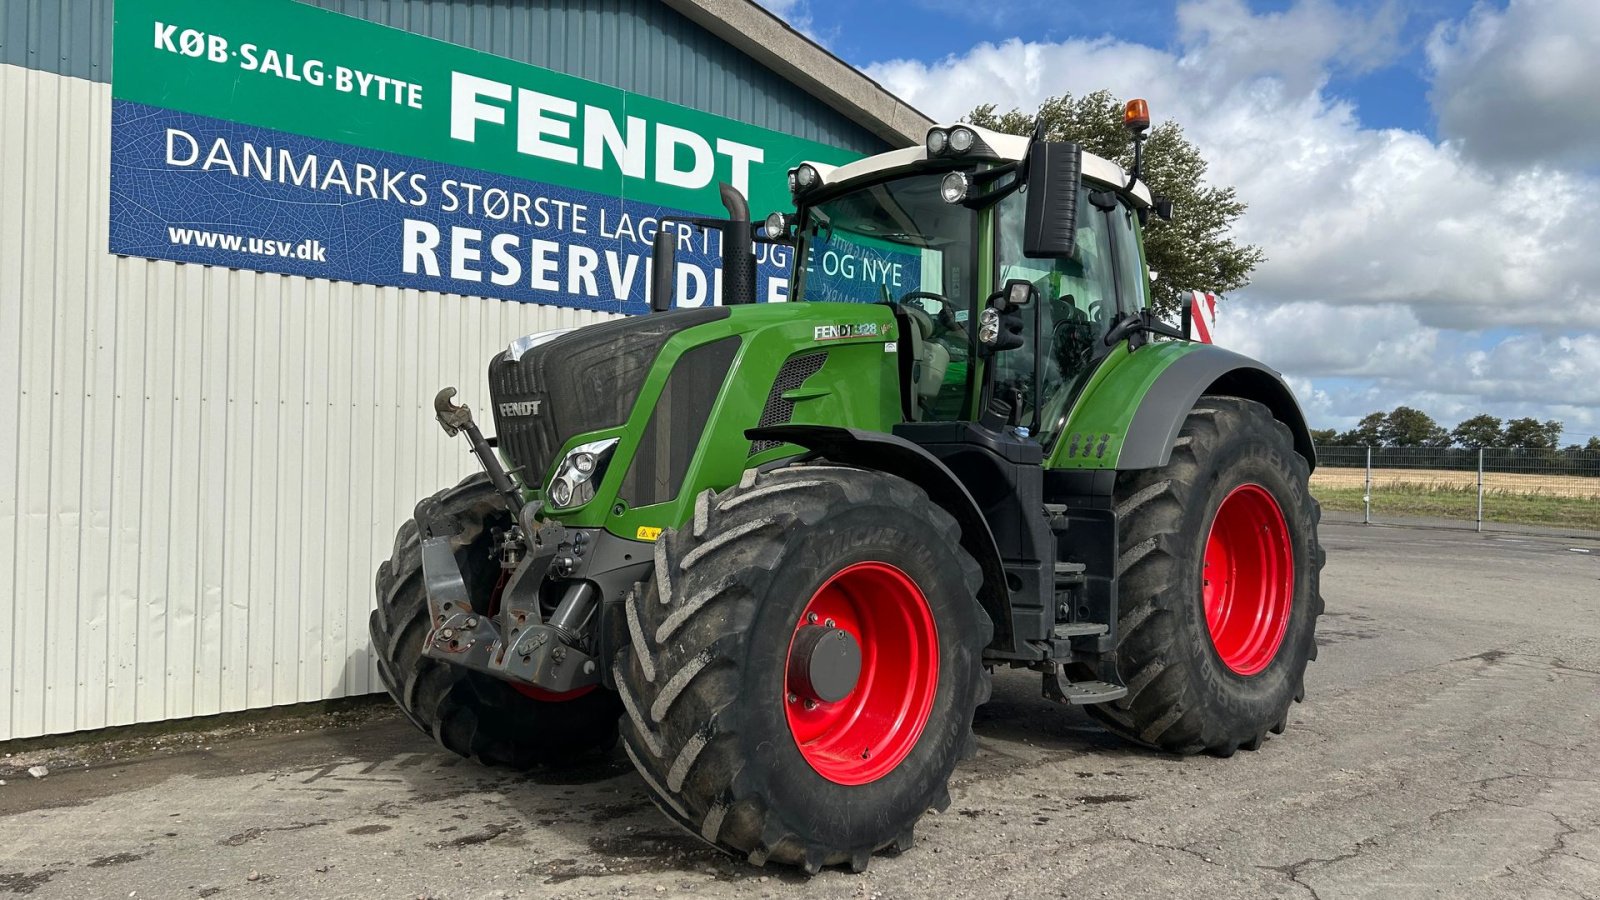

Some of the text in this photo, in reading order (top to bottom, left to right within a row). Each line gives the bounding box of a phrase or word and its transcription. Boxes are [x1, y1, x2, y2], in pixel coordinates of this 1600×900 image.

[450, 70, 764, 201] FENDT
[165, 128, 428, 207] DANMARKS
[441, 180, 588, 235] STØRSTE
[822, 250, 855, 279] OG
[862, 257, 902, 287] NYE
[168, 226, 326, 262] www.usv.dk
[814, 324, 854, 339] FENDT
[499, 400, 542, 417] FENDT
